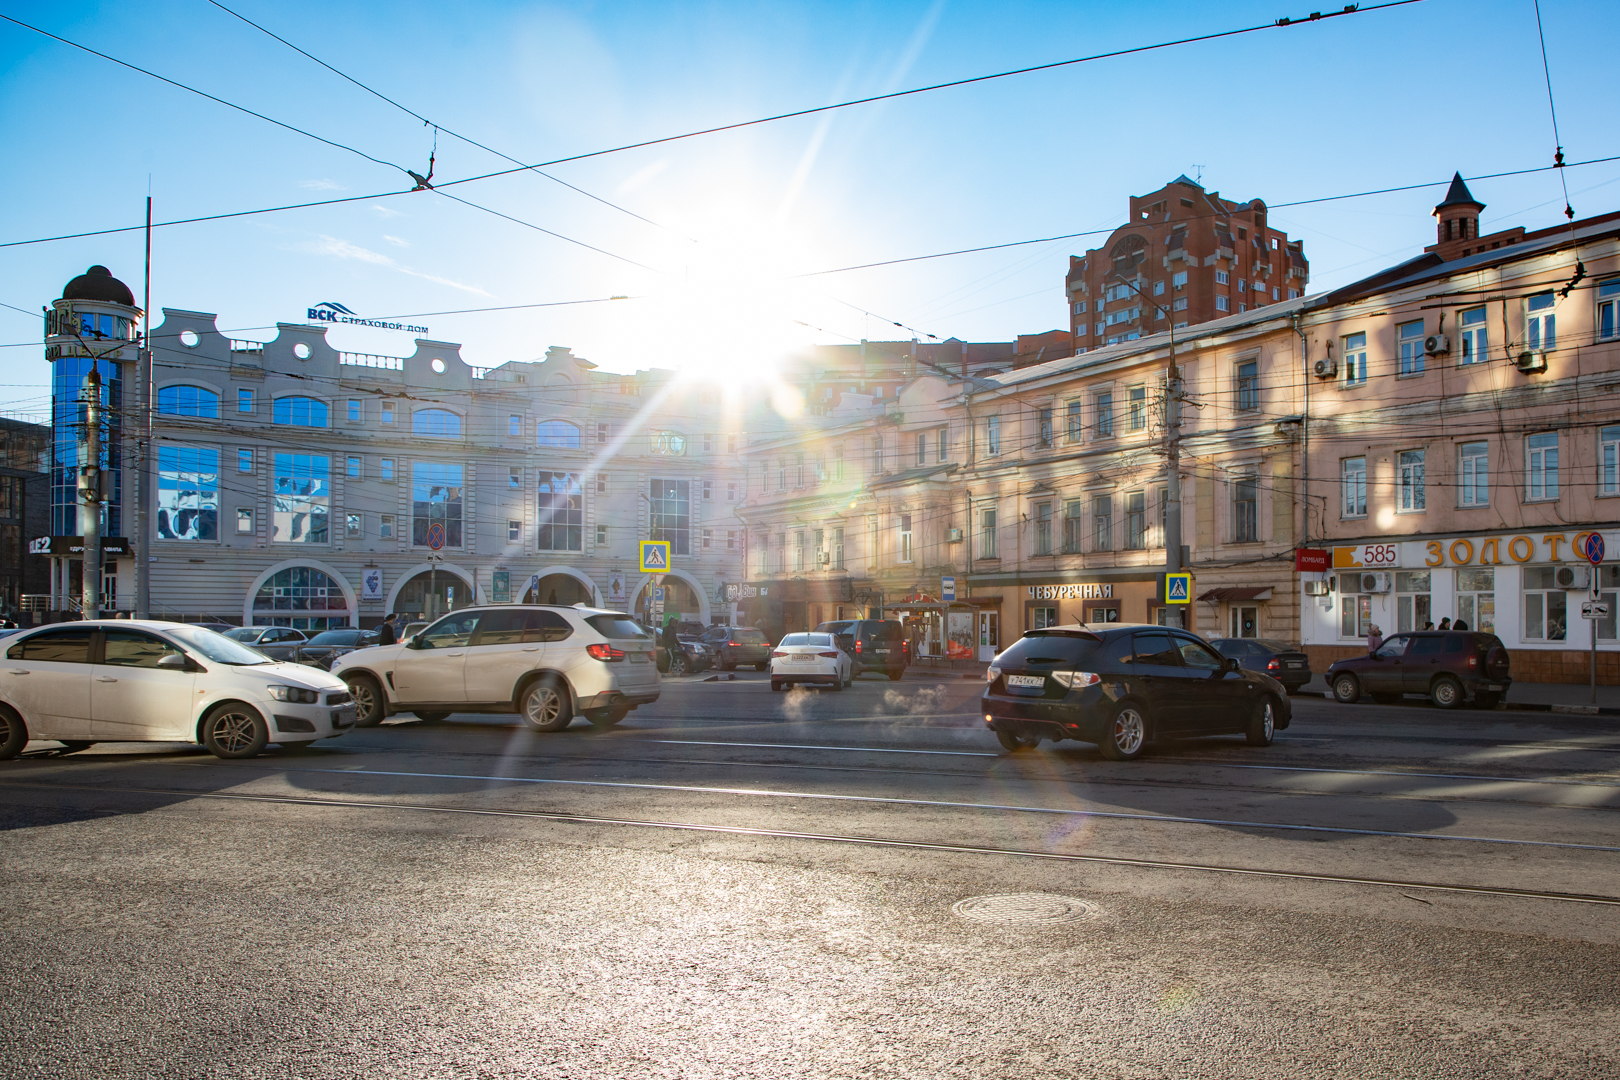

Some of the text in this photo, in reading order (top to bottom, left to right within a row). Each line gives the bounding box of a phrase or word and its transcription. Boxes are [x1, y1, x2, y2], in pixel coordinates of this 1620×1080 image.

[308, 308, 429, 334] ВСК СТРАХОВОЙ ДОМ
[1364, 544, 1396, 564] 585
[1425, 532, 1592, 566] ЗОЛОТО
[1300, 556, 1325, 564] ЛОМБАРД
[1028, 584, 1113, 600] ЧЕБУРЕЧНАЯ
